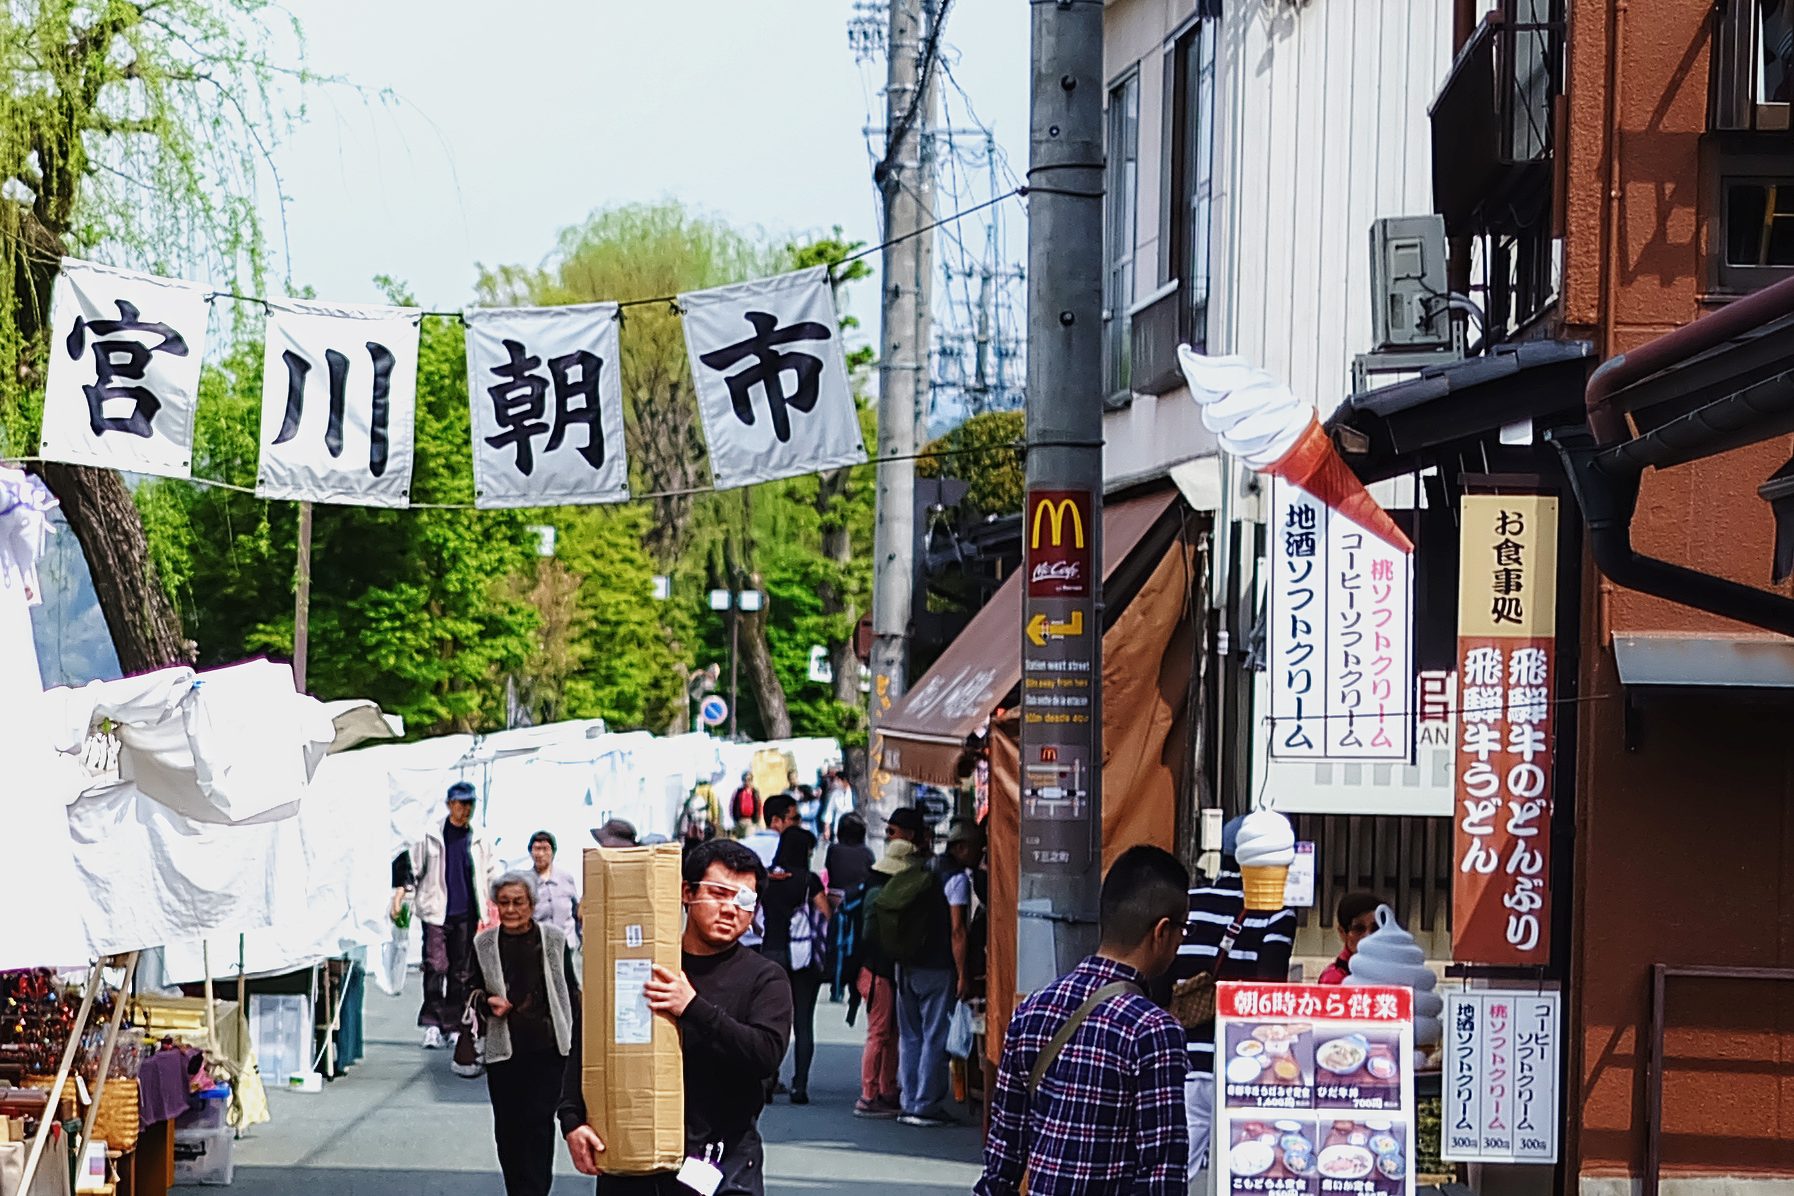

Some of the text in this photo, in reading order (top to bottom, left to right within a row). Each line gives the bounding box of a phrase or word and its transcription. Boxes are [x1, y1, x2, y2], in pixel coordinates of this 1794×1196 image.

[1285, 504, 1316, 749] 地酒ソフトクリーム
[1492, 510, 1525, 624] お食事処
[1339, 534, 1363, 748] コーヒーソフトクリーム
[1370, 559, 1394, 748] 桃ソフトクリーム
[1461, 647, 1503, 874] 飛騨牛うどん
[1504, 647, 1548, 950] 飛騨牛のどんぶり
[1234, 990, 1398, 1019] 朝6時から営業
[1455, 1003, 1475, 1130] 地酒ソフトクリーム
[1488, 1004, 1508, 1130] 桃ソフトクリーム
[1534, 1005, 1551, 1060] コーヒー
[1354, 1098, 1383, 1109] 700円
[1517, 1033, 1534, 1131] ソフトクリーム
